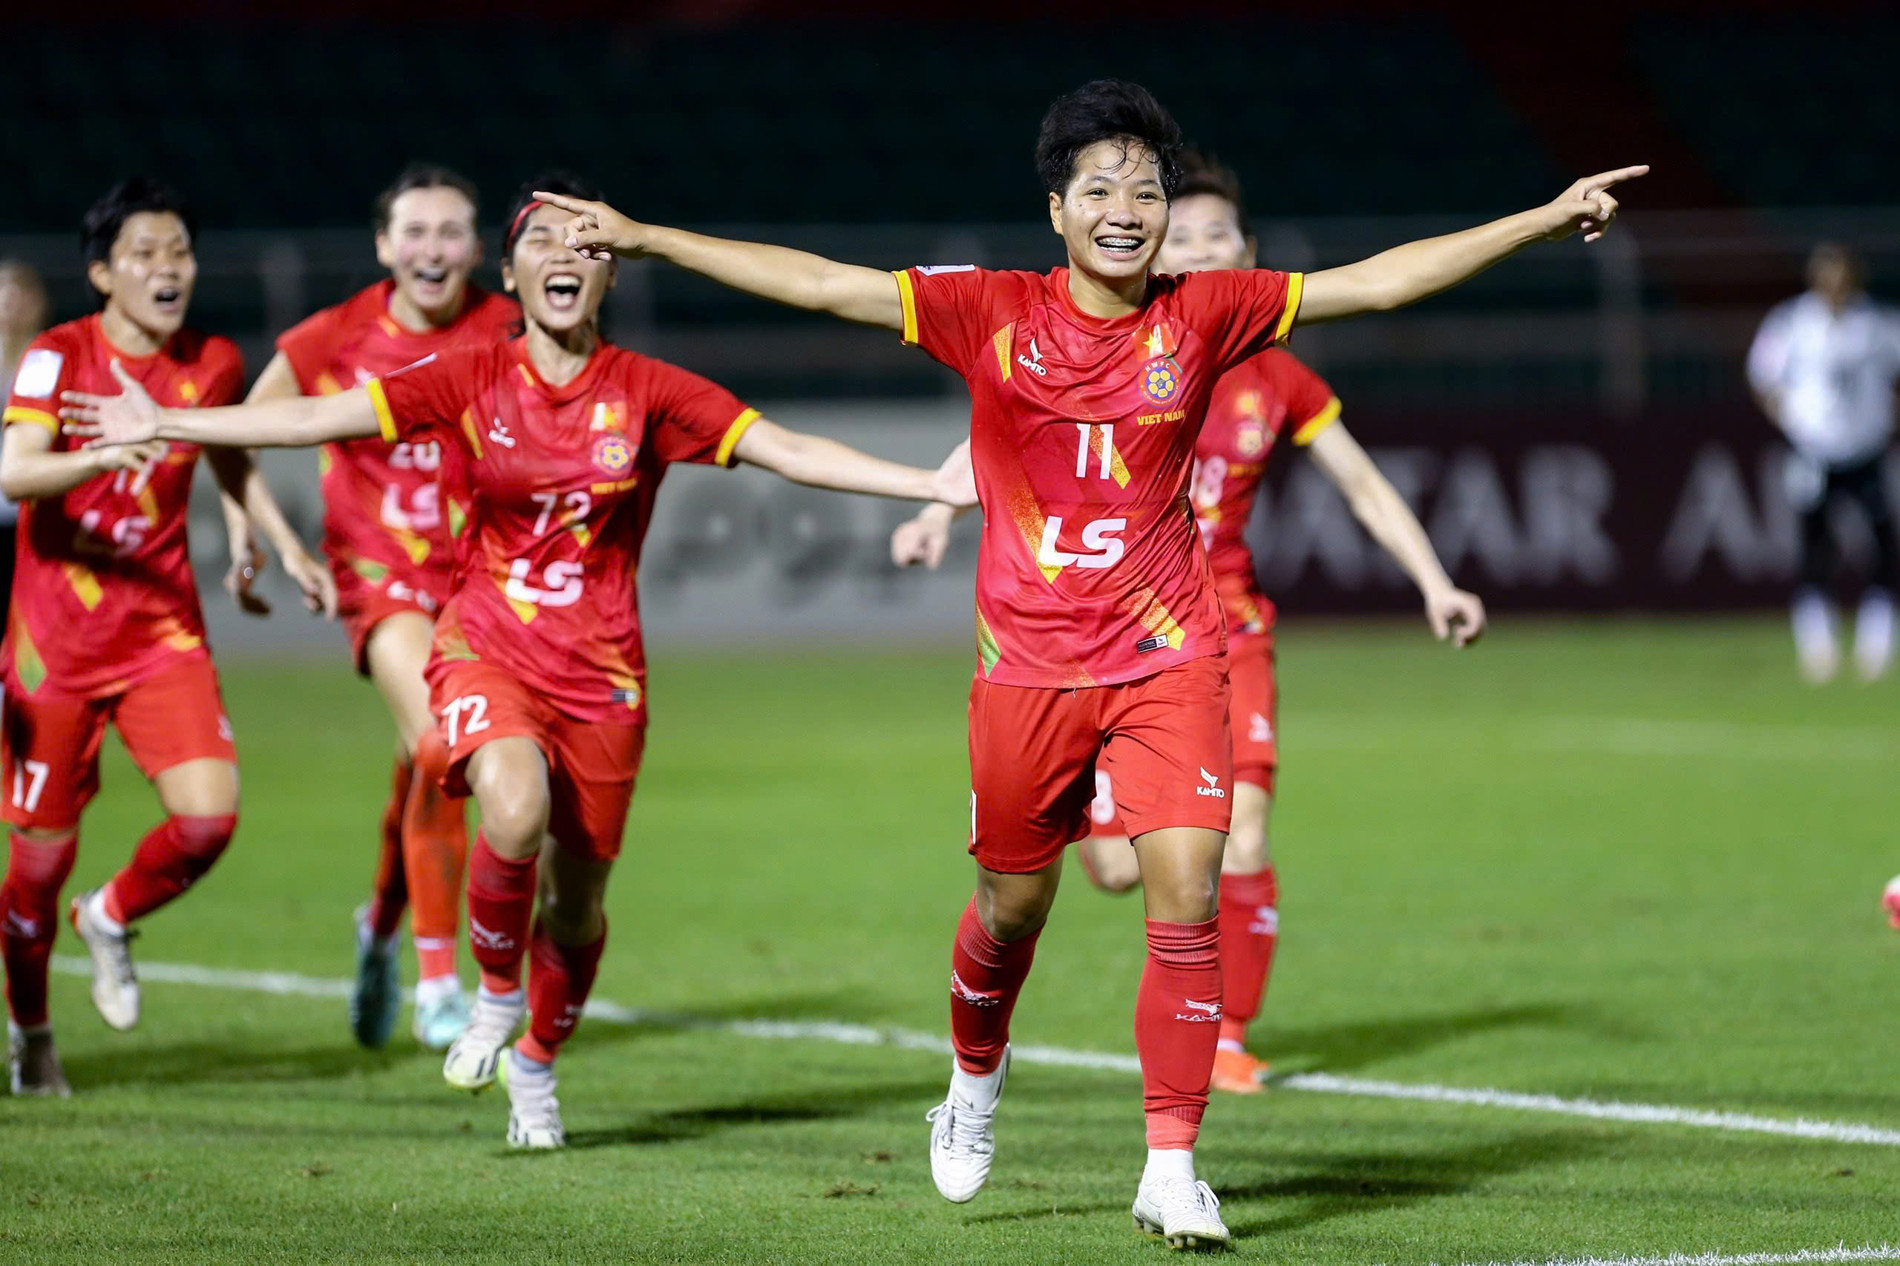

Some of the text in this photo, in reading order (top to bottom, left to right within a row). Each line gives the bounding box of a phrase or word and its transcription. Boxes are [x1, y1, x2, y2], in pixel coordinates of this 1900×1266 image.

[1137, 409, 1185, 426] VIET NAM
[1076, 423, 1114, 480] 11
[530, 490, 592, 537] 72
[1038, 515, 1128, 569] LS
[505, 557, 585, 607] LS
[11, 758, 50, 814] 17
[1196, 786, 1225, 799] KAMITO
